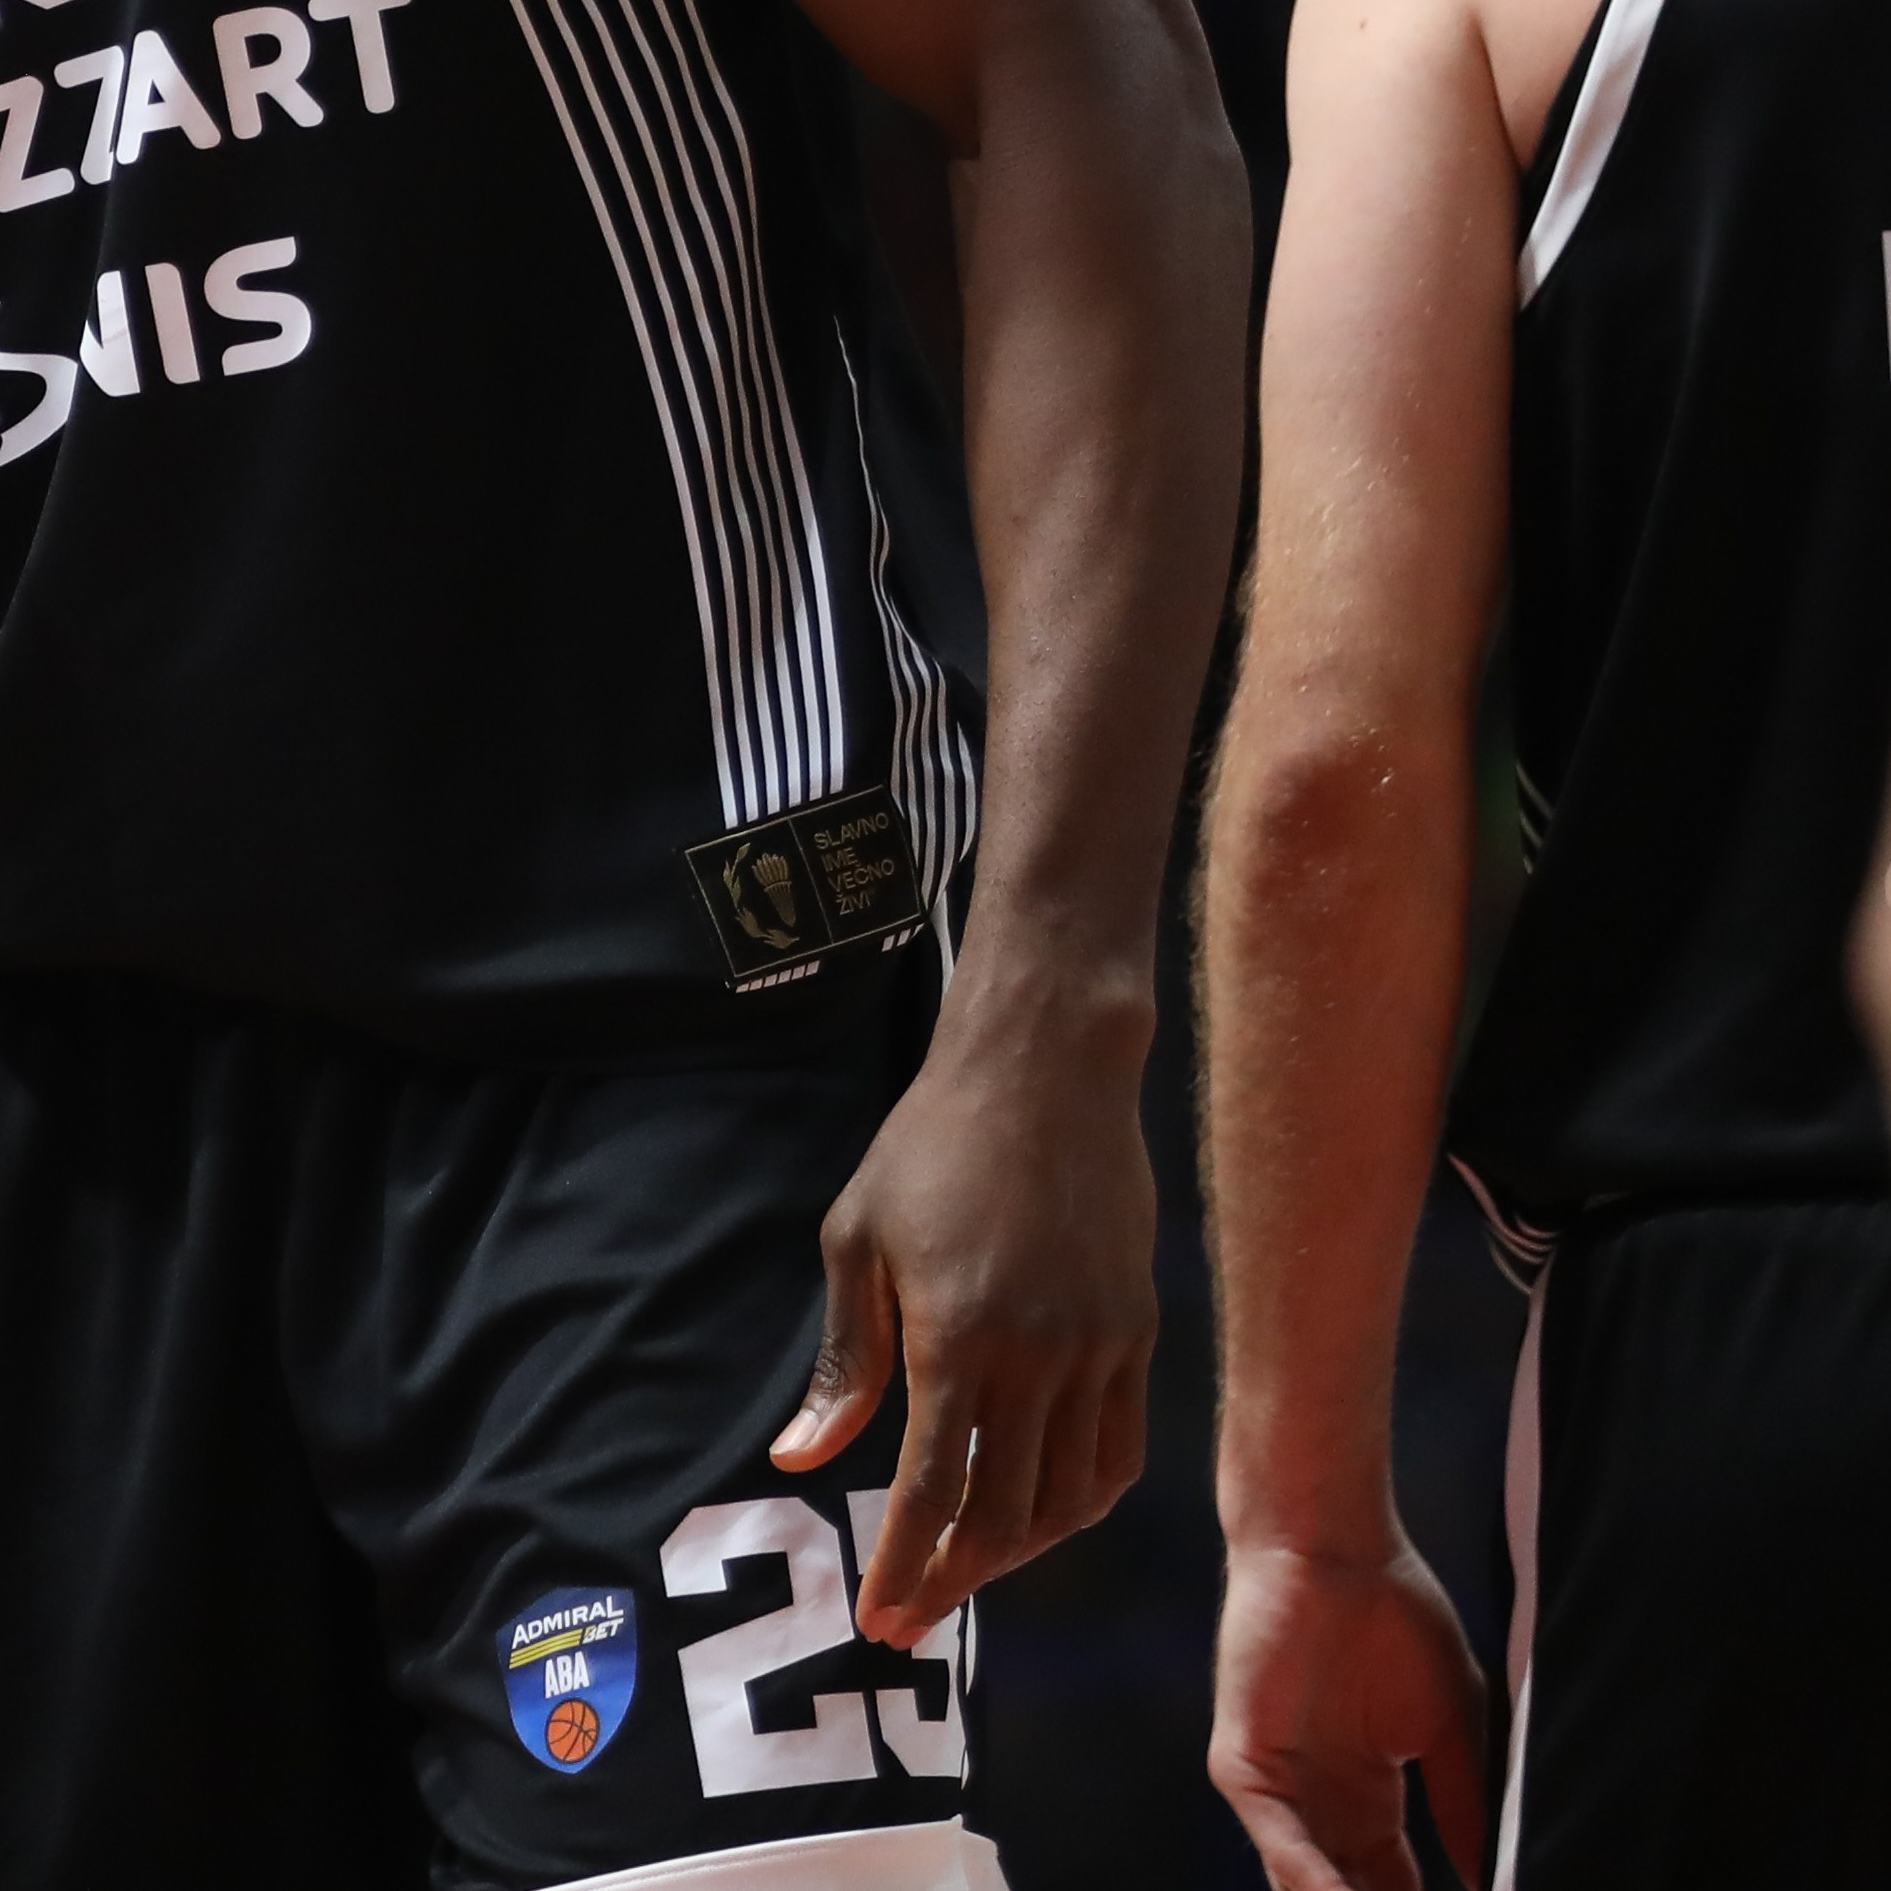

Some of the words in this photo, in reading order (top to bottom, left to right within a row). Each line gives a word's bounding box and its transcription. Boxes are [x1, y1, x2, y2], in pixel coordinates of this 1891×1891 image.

[80, 235, 313, 399] NIS
[813, 812, 890, 849] SLAVNO
[511, 1595, 624, 1650] ADMIRAL
[582, 1617, 624, 1645] BET
[544, 1650, 590, 1699] ABA
